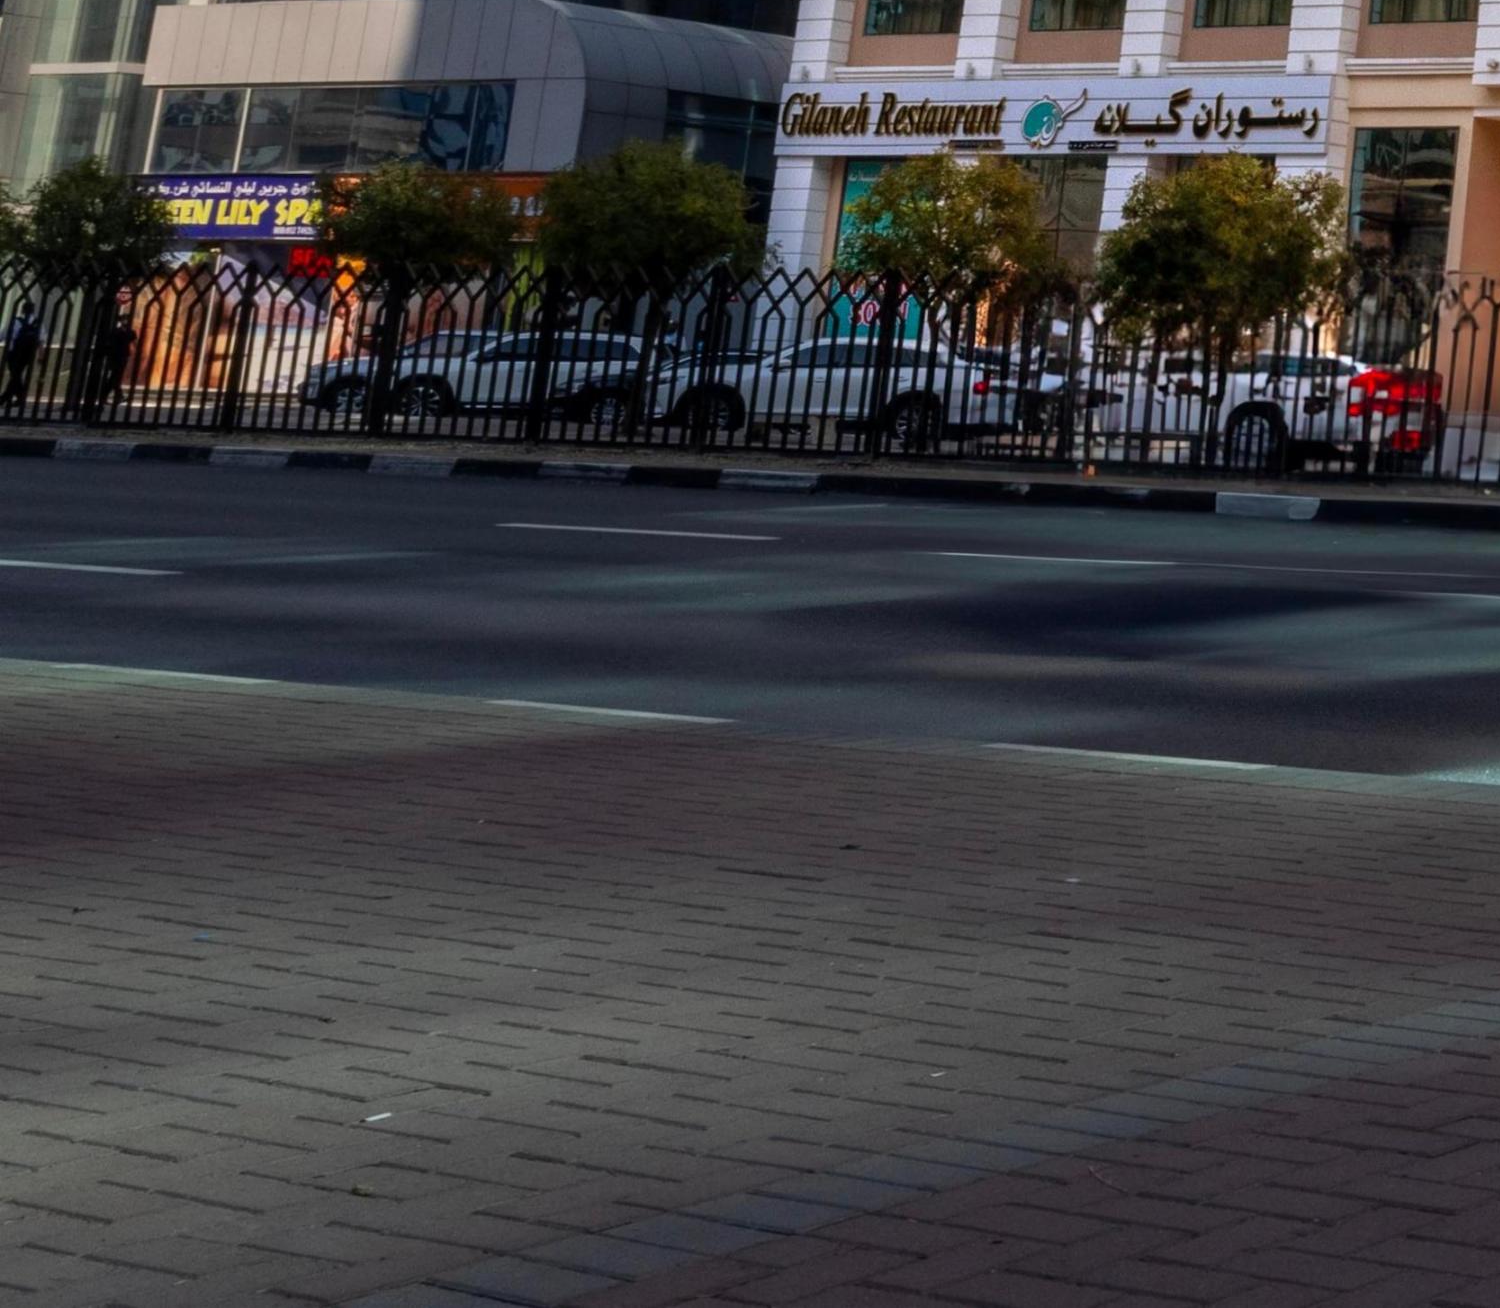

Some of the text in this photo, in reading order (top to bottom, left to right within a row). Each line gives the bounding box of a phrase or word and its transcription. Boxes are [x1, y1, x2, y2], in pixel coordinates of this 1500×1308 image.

[781, 91, 1007, 137] Gilaneh Restaurant
[1192, 92, 1320, 140] رستوران
[215, 198, 270, 226] LILY
[274, 198, 323, 226] SPA
